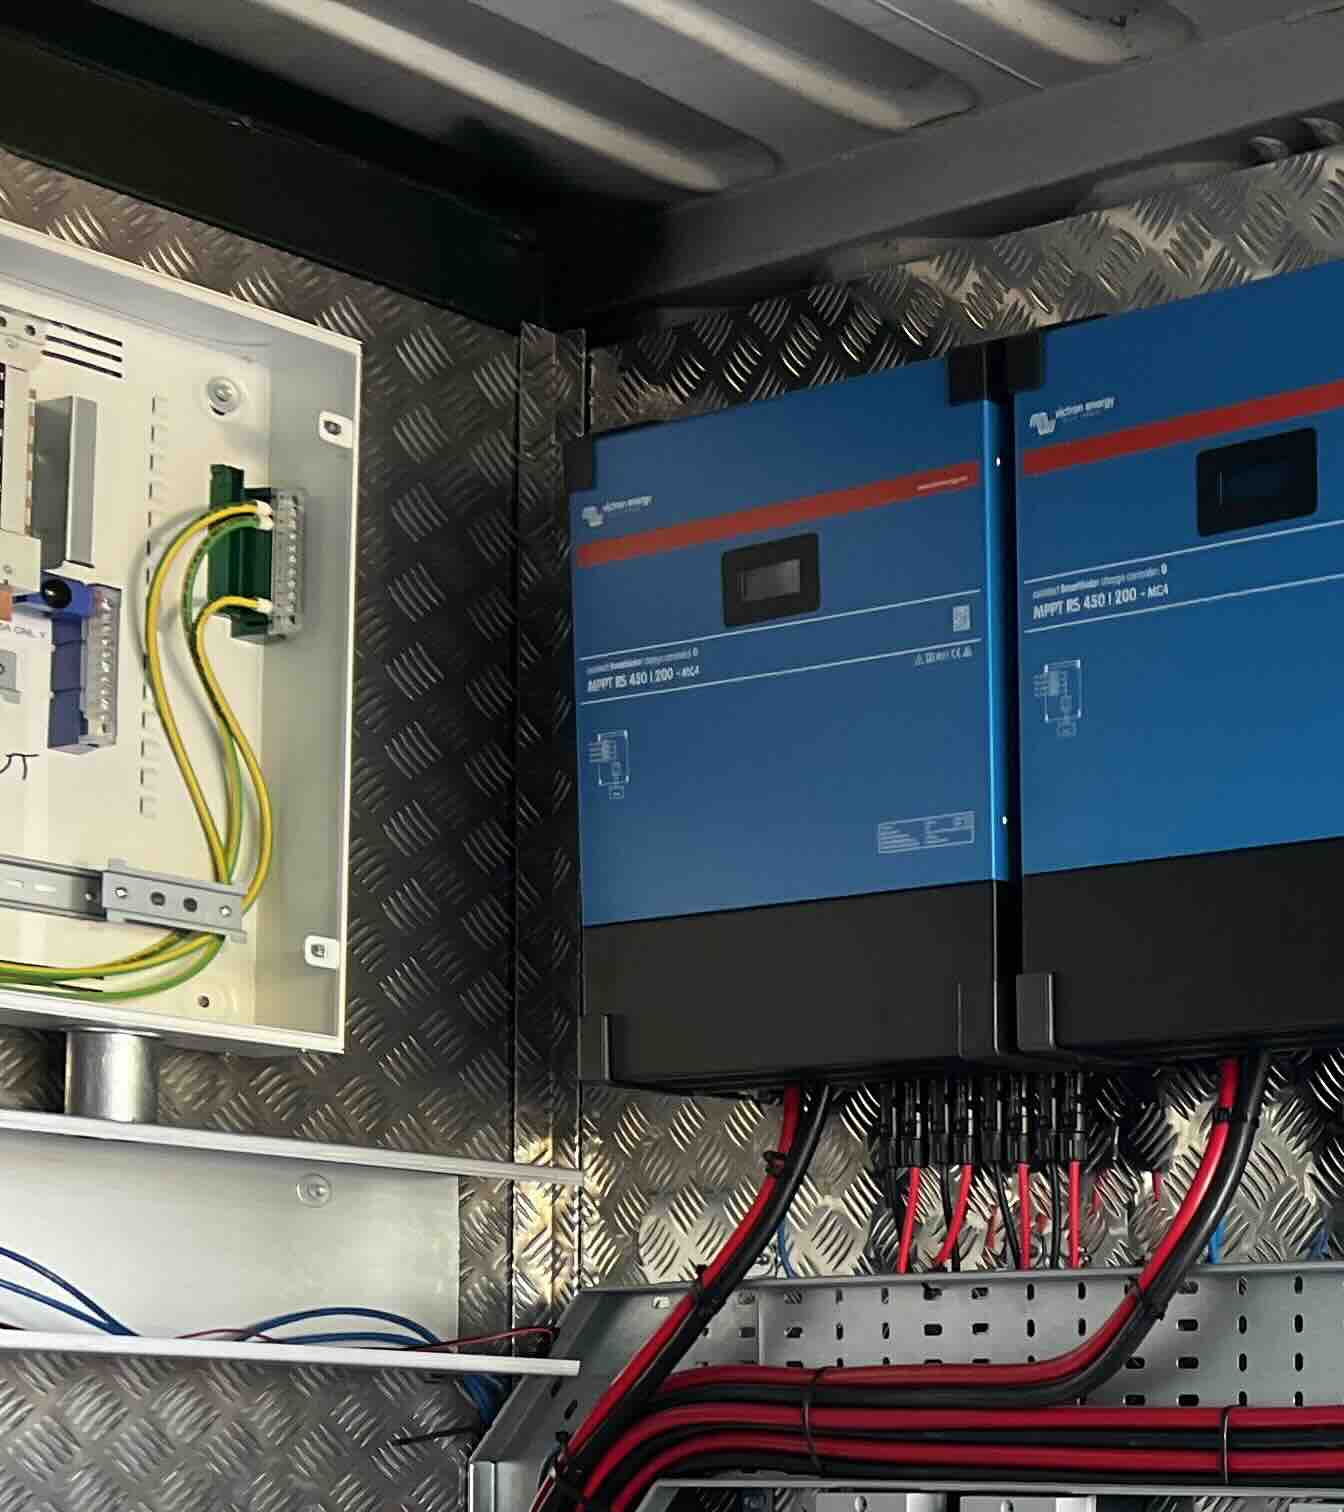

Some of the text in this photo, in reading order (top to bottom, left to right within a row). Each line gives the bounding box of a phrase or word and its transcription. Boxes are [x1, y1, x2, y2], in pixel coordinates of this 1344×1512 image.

[1033, 600, 1064, 619] MPPT
[1083, 592, 1105, 609] 450
[1115, 587, 1137, 605] 200
[655, 666, 674, 682] 200
